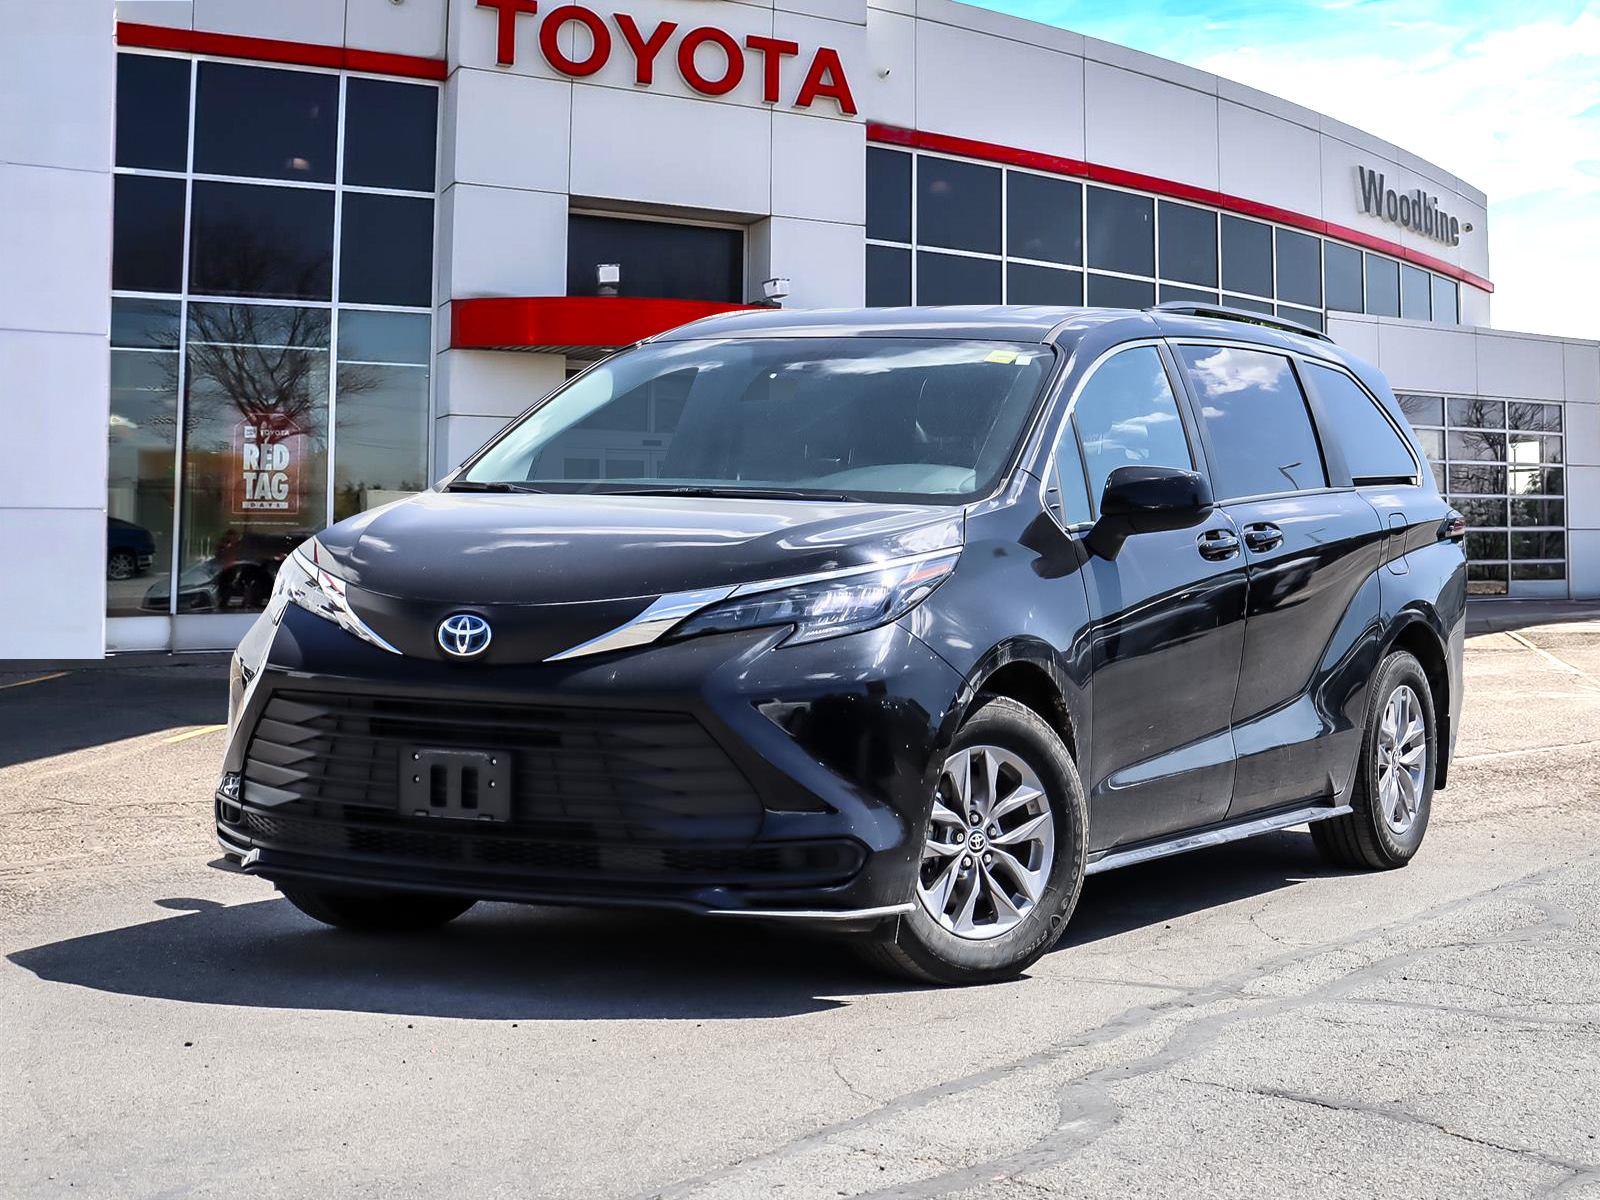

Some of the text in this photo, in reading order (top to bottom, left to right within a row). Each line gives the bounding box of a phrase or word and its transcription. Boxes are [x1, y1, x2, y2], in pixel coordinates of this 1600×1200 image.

[476, 0, 859, 116] TOYOTA
[1356, 165, 1460, 247] Woodbine
[260, 429, 290, 437] TOYOTA
[243, 443, 290, 471] RED
[243, 472, 289, 500] TAG
